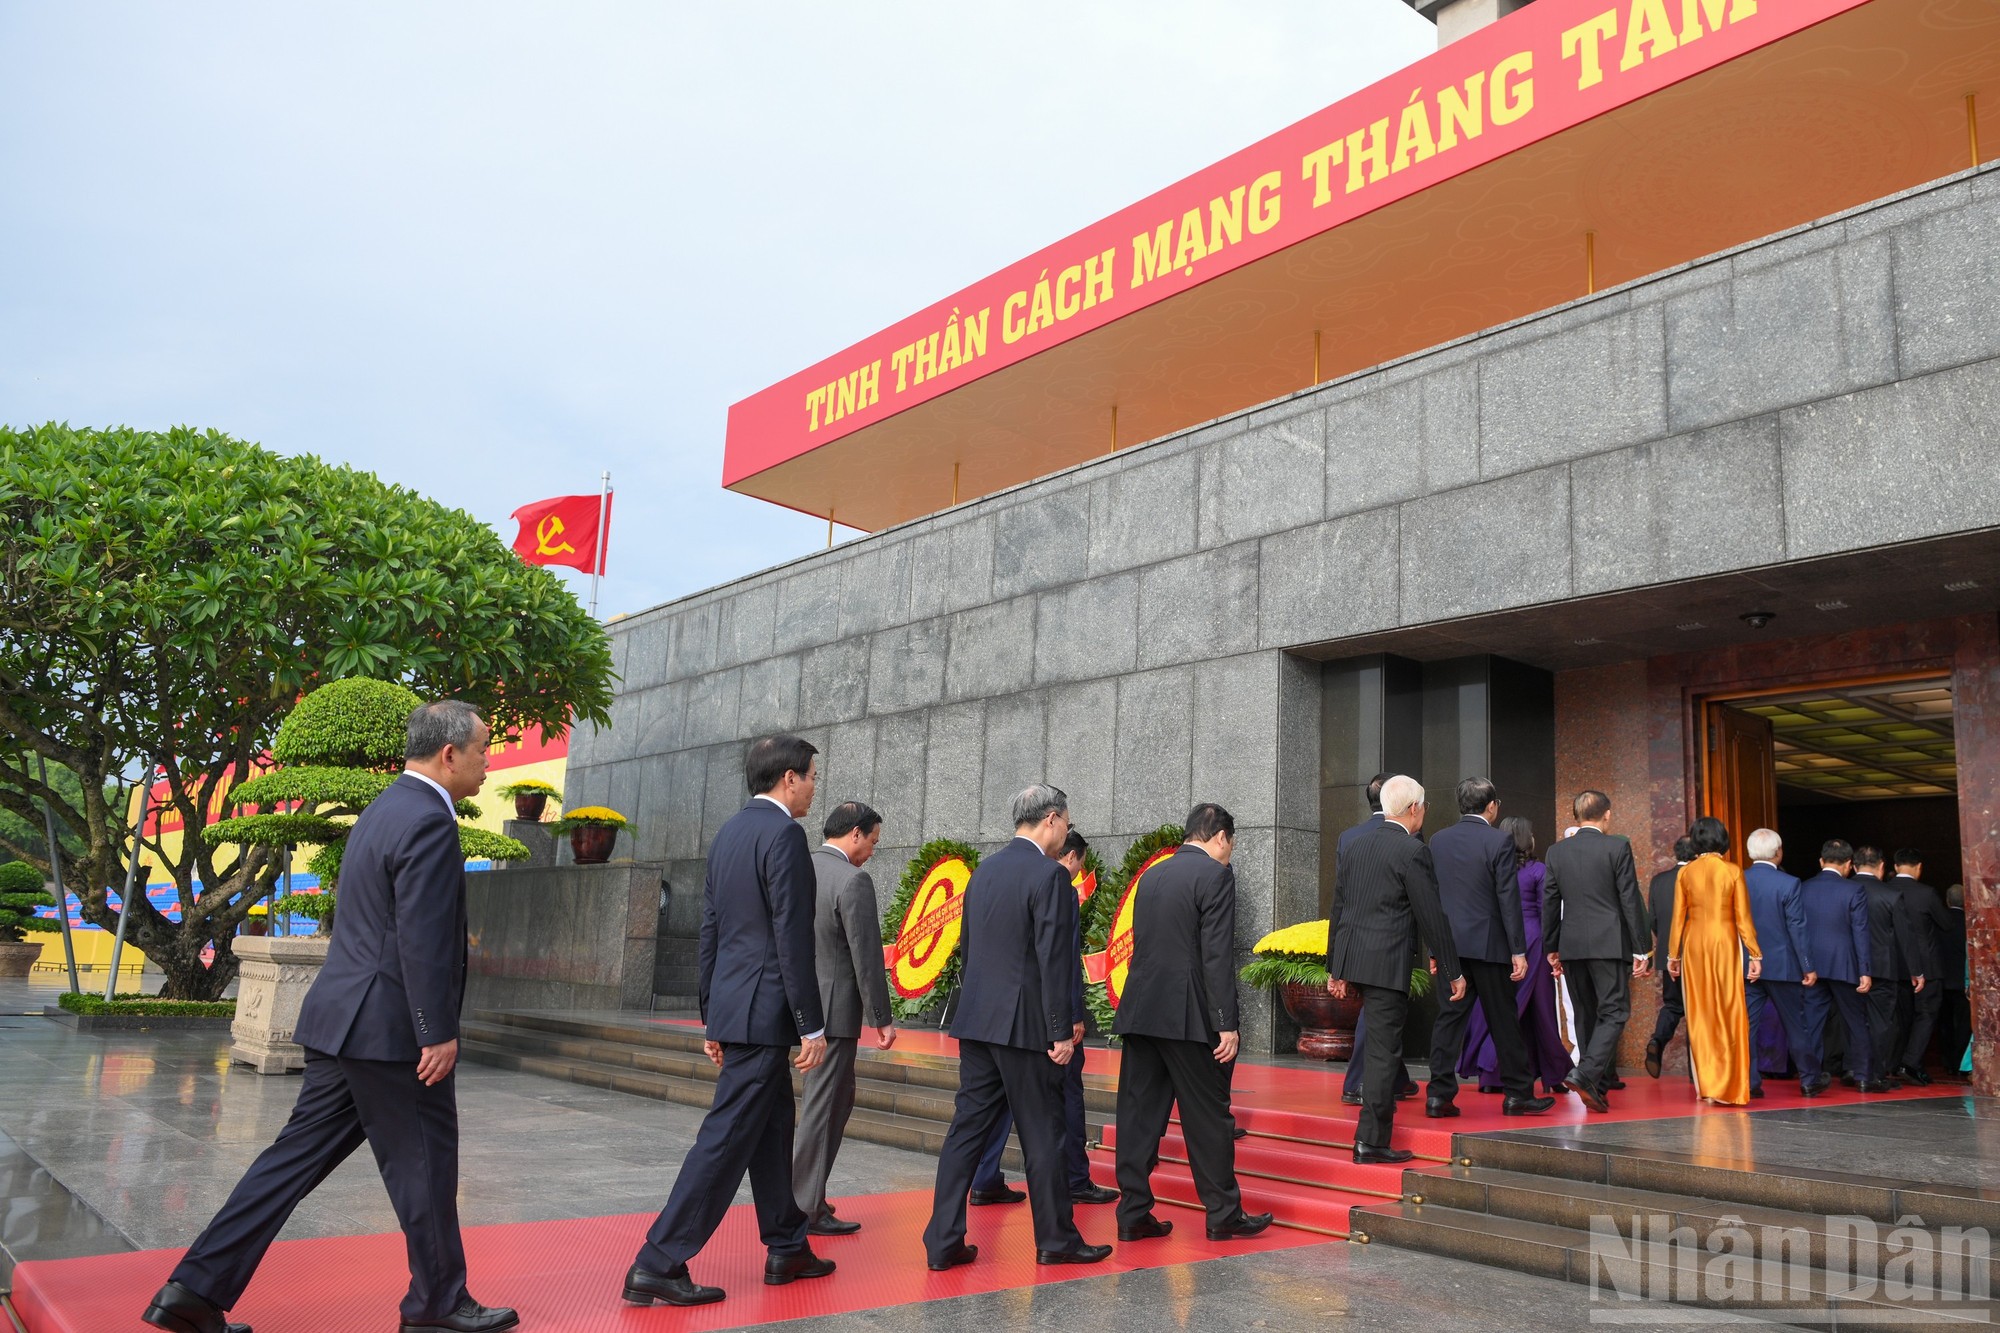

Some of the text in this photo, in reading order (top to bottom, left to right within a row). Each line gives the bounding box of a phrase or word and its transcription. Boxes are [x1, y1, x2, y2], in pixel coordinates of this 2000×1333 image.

[805, 359, 882, 432] TINH
[891, 306, 990, 394] THẦN
[1002, 247, 1116, 345] CÁCH
[1130, 170, 1282, 289] MẠNG
[1302, 50, 1534, 209] THÁNG
